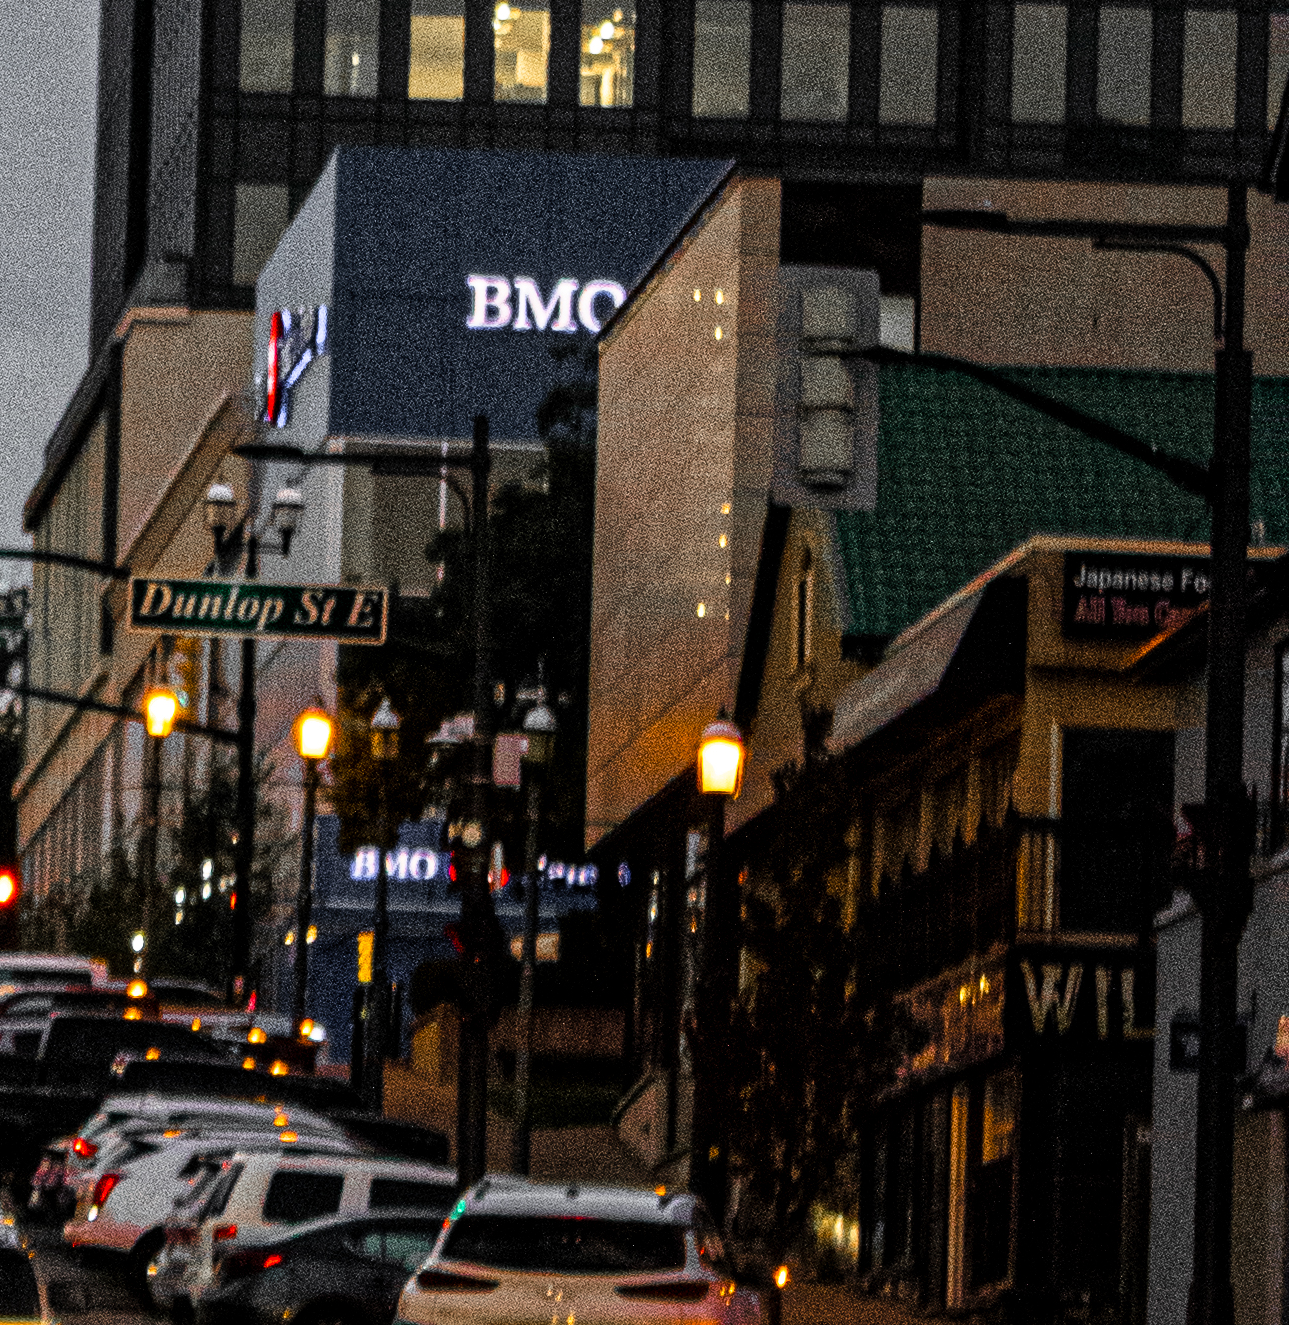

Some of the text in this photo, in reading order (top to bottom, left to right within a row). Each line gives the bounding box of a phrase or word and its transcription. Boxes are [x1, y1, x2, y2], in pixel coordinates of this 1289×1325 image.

[1074, 562, 1174, 594] Japanese
[139, 582, 379, 631] Dunlop St E
